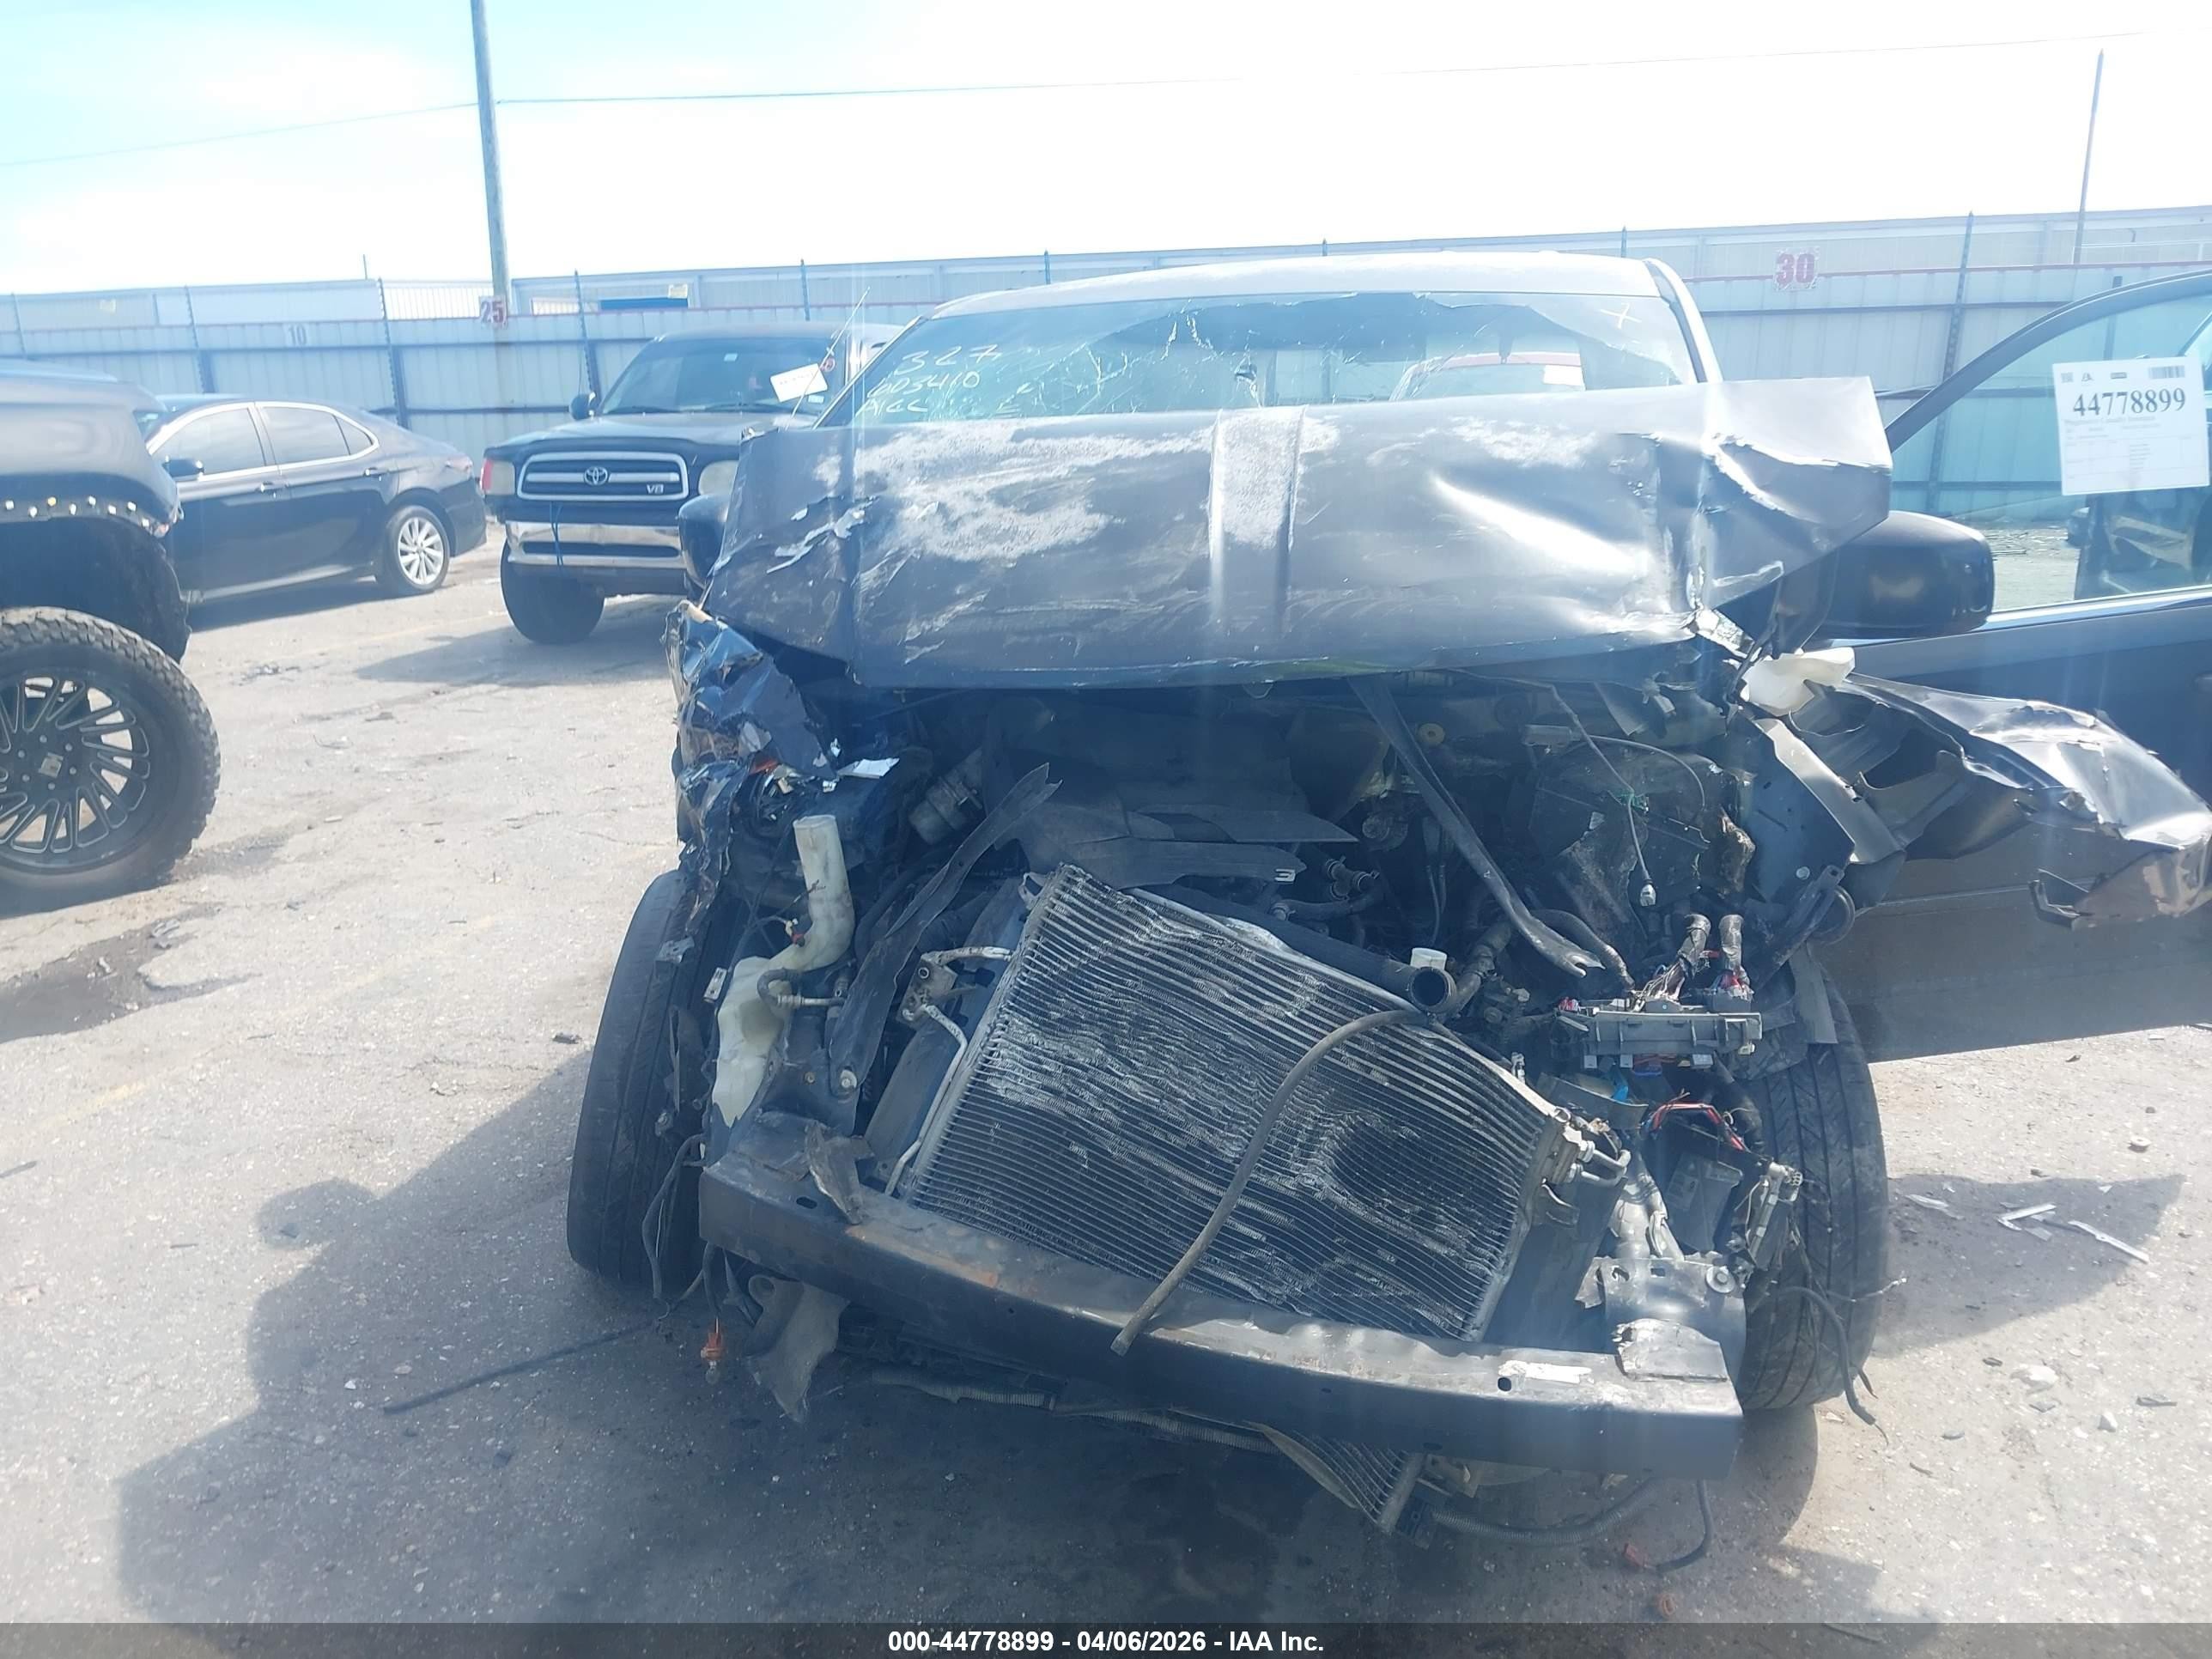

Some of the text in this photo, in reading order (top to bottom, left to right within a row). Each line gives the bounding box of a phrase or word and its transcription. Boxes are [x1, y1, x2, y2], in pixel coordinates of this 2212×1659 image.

[1776, 253, 1814, 288] 30
[481, 301, 504, 323] 25
[2072, 387, 2186, 417] 44778899
